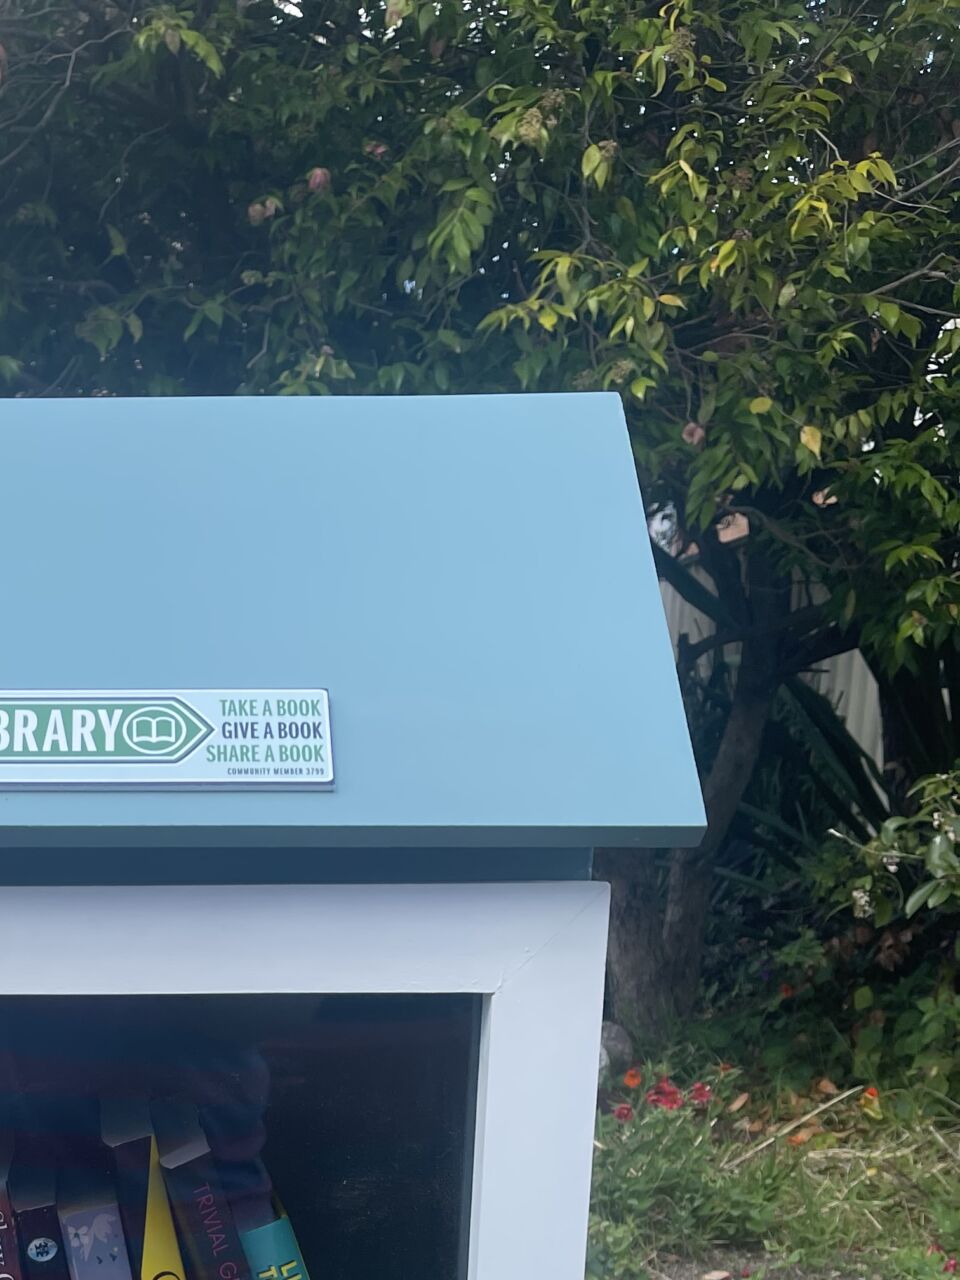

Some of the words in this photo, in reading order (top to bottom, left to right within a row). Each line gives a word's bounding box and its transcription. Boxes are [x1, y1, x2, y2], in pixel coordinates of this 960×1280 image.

[220, 699, 258, 717] TAKE
[262, 699, 273, 717] A
[276, 699, 322, 717] BOOK
[221, 721, 260, 739] GIVE
[263, 721, 274, 739] A
[278, 721, 323, 739] BOOK
[206, 744, 260, 763] SHARE
[265, 744, 275, 763] A
[279, 744, 325, 763] BOOK
[192, 1183, 222, 1258] TRIVIAL
